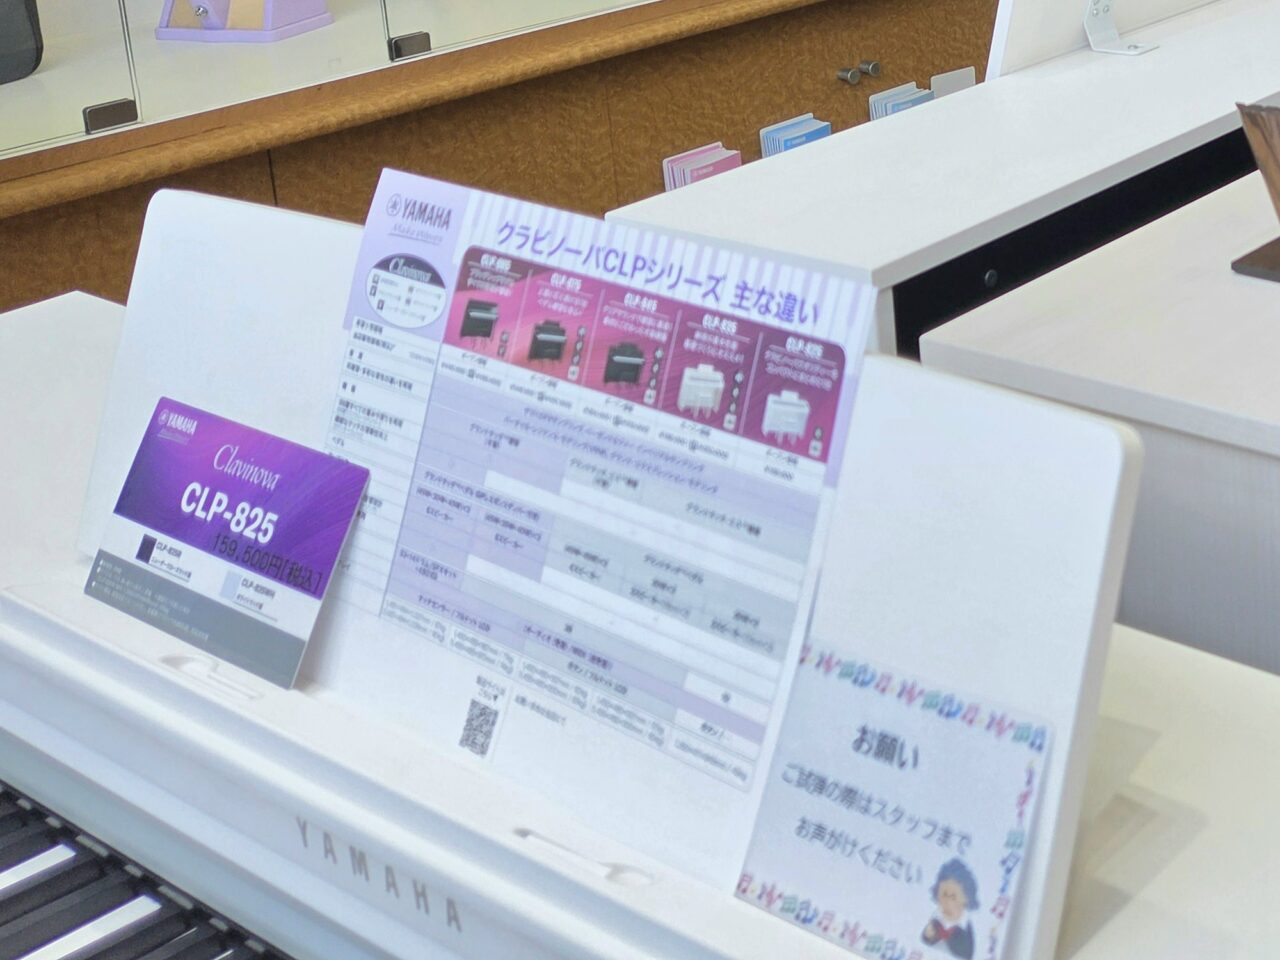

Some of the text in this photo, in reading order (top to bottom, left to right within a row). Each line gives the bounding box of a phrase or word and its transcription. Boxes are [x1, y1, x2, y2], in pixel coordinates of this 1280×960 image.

[400, 197, 453, 231] YAMAHA
[729, 279, 820, 324] 主な違い
[167, 411, 198, 436] YAMAHA
[213, 443, 282, 492] Clavinova
[180, 481, 279, 544] CLP-825
[852, 723, 920, 770] お願い
[793, 816, 923, 884] お声がけください
[296, 815, 463, 934] YAMAHA
